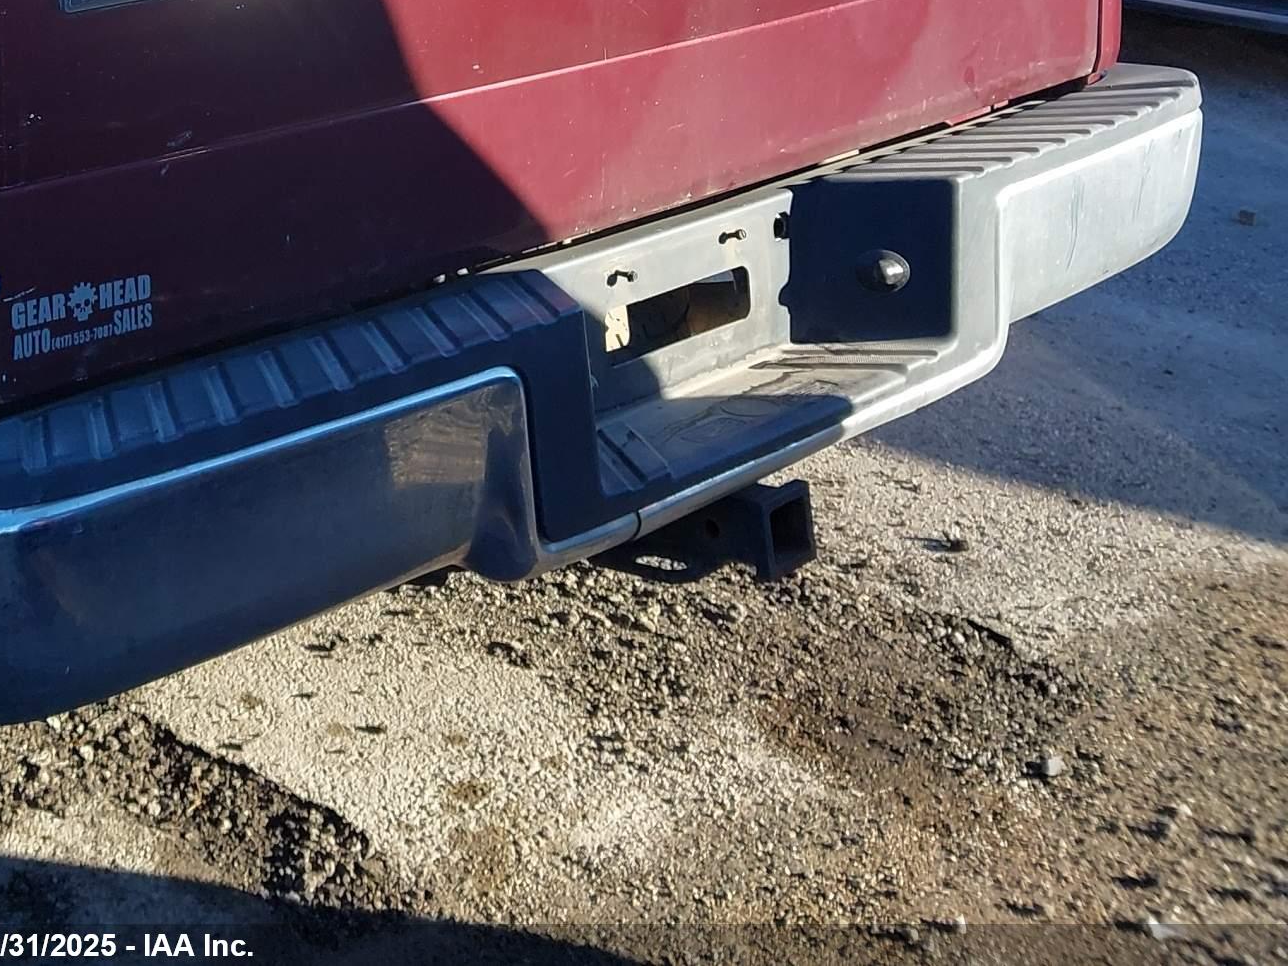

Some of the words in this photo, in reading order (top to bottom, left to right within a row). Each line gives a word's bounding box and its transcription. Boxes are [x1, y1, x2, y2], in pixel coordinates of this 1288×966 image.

[12, 293, 66, 330] GEAR
[99, 274, 152, 309] HEAD
[14, 329, 51, 360] AUTO
[113, 302, 153, 335] SALES
